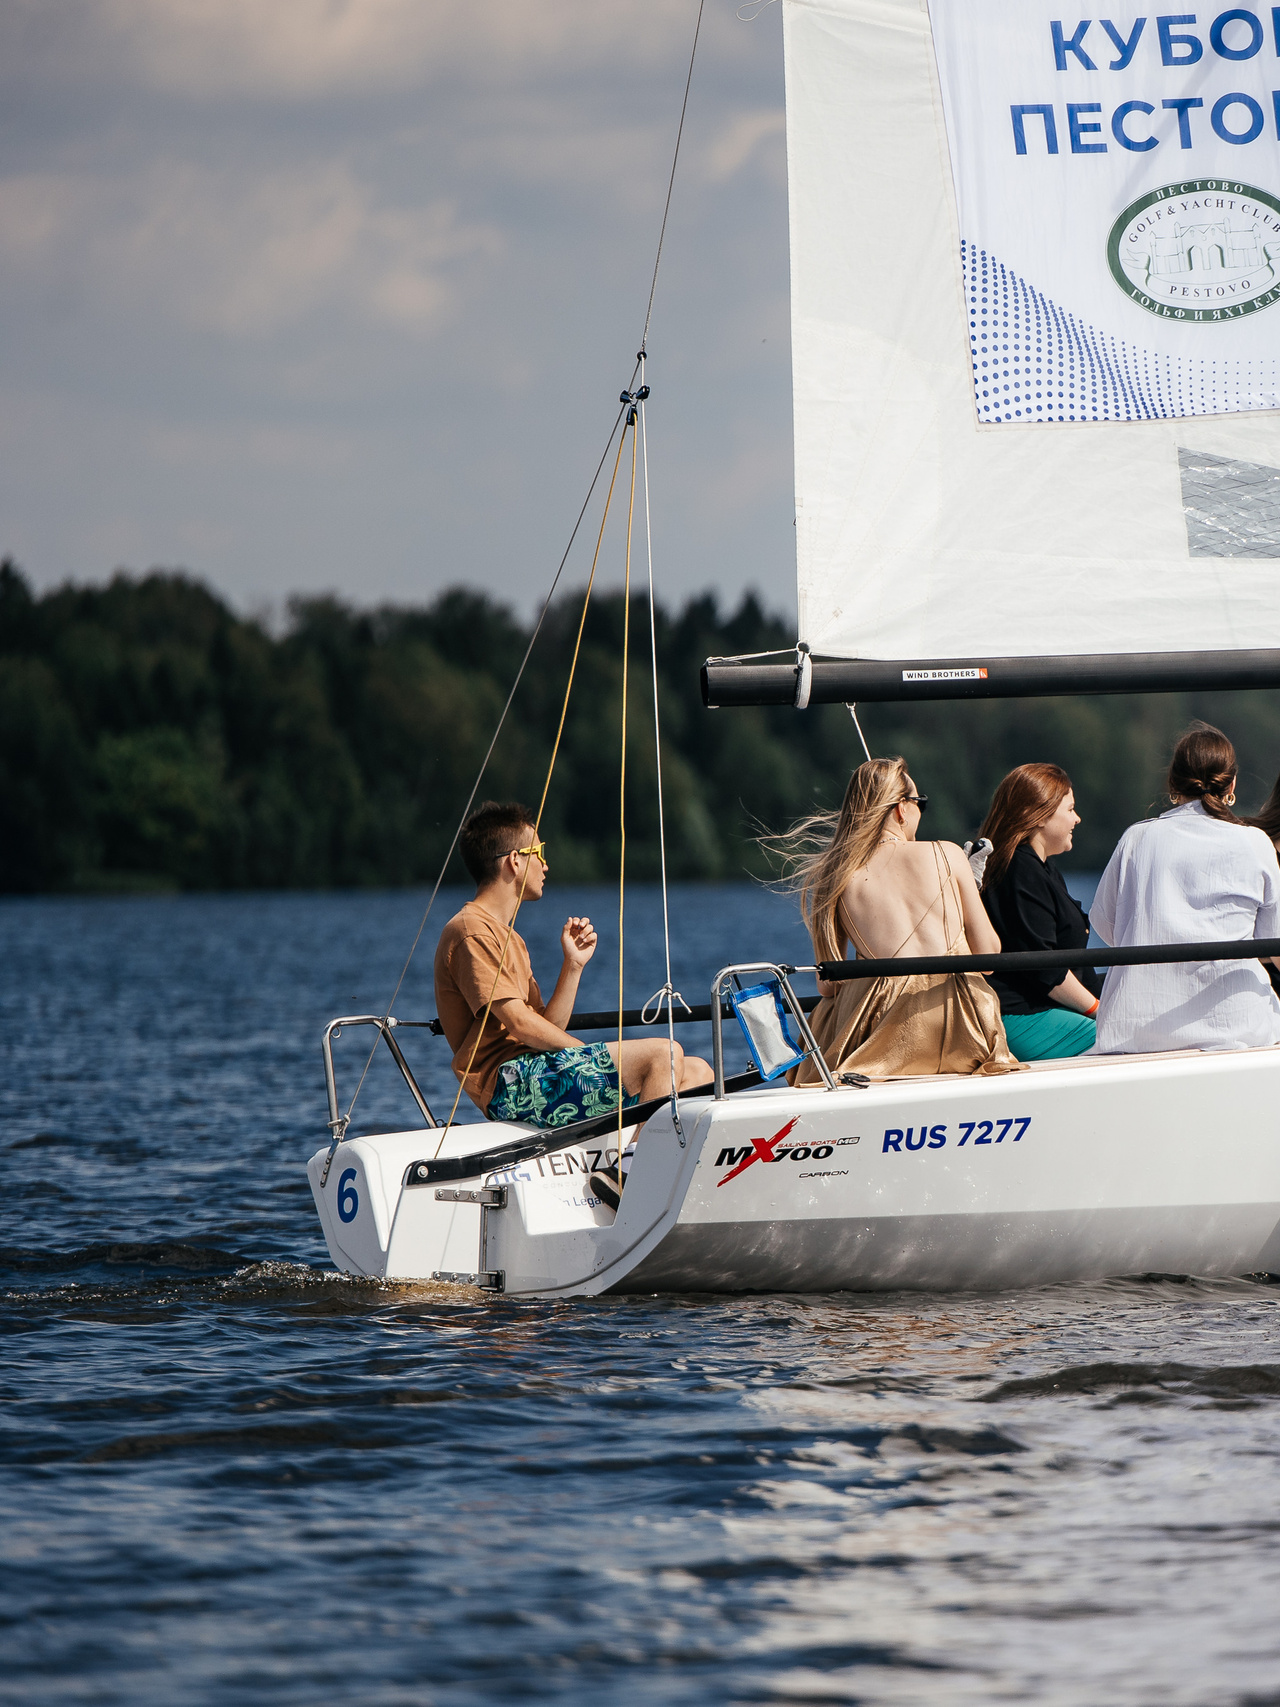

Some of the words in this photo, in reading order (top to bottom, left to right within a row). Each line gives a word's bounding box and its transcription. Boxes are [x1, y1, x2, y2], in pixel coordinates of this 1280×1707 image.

[1155, 180, 1244, 200] ПЕСТОВО
[1128, 208, 1163, 243] GOLF
[1167, 205, 1176, 215] &
[1180, 198, 1236, 211] YACHT
[1169, 280, 1251, 298] PESTOVO
[1130, 289, 1186, 318] ГОЛЬФ
[1194, 310, 1203, 320] И
[1212, 304, 1245, 320] ЯХТ
[932, 670, 976, 678] BROTHERS
[882, 1124, 948, 1153] RUS
[956, 1116, 1032, 1147] 7277
[798, 1170, 850, 1178] CARBON
[337, 1167, 359, 1223] 6
